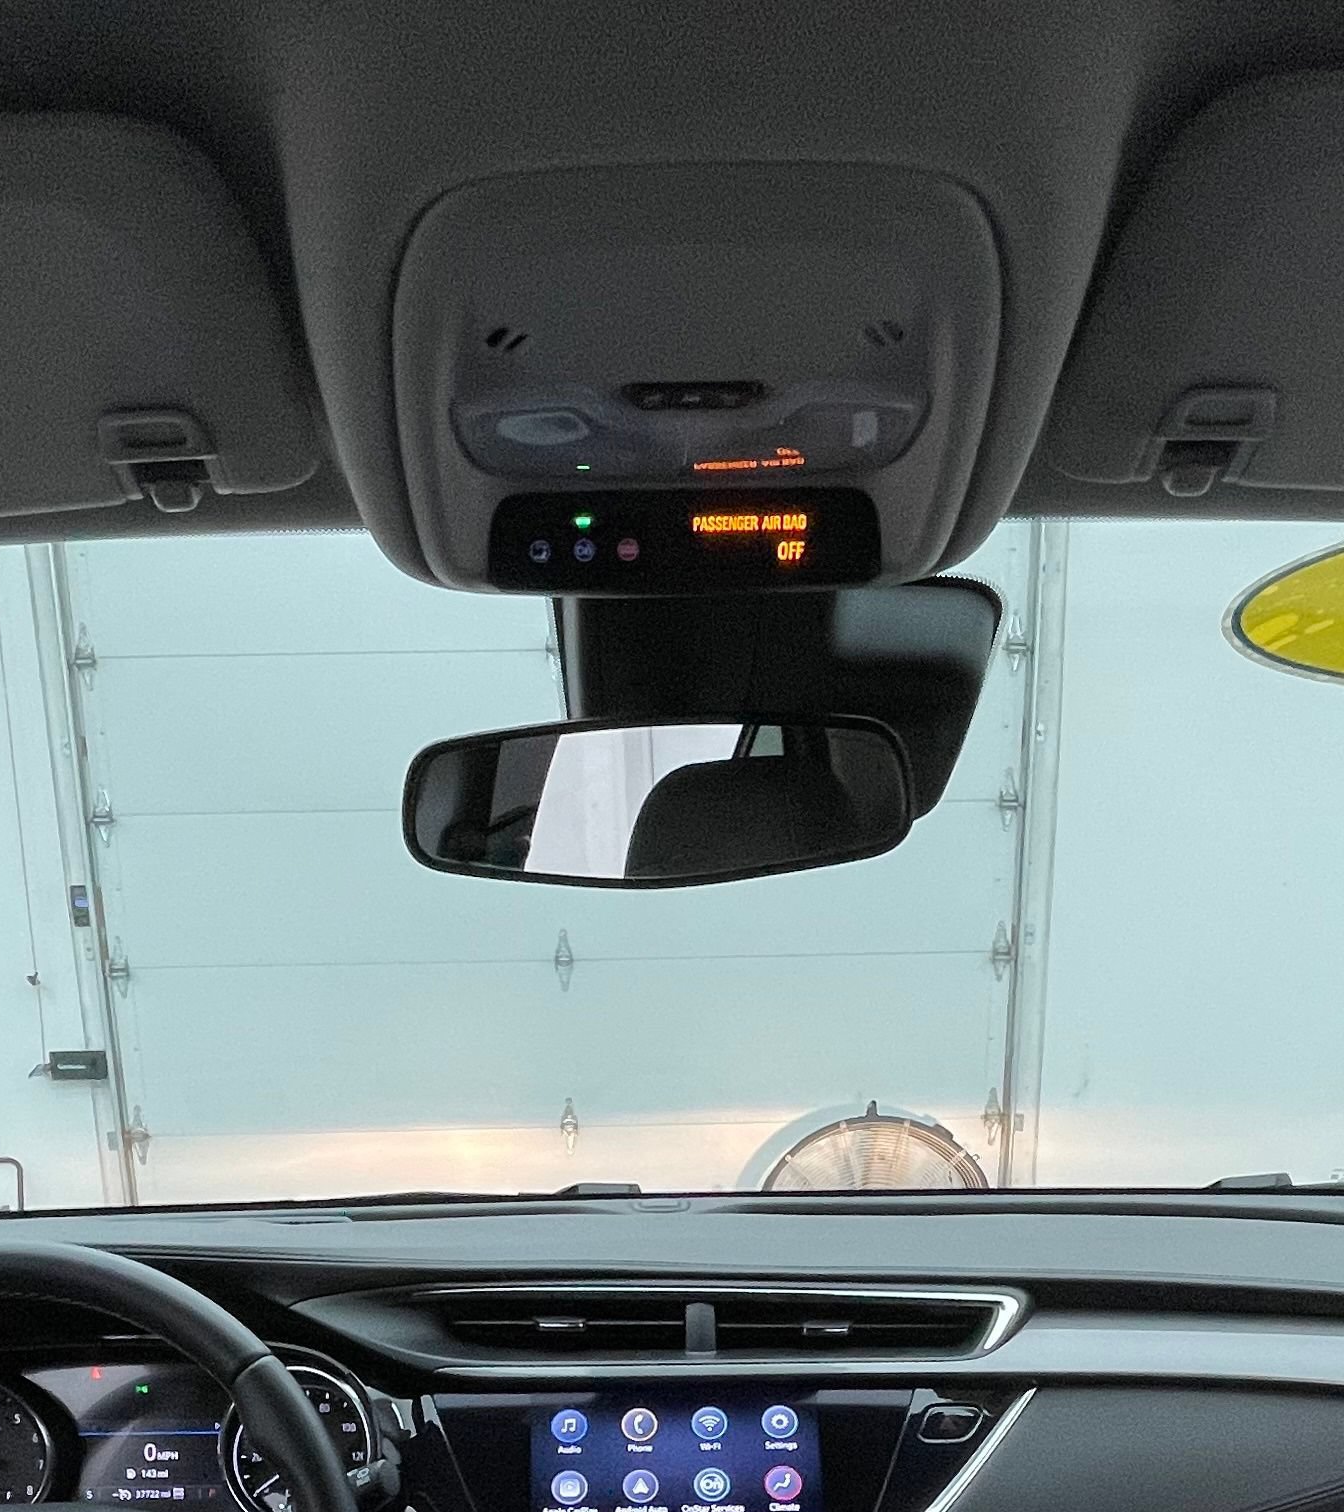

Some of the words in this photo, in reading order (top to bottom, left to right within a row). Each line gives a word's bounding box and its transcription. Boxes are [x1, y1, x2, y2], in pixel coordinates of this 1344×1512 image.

[692, 515, 759, 532] PASSENGER
[761, 515, 782, 531] AIR
[783, 513, 807, 531] BAG
[777, 541, 805, 560] OFF
[14, 1413, 21, 1425] 5
[32, 1433, 39, 1443] 6
[557, 1445, 582, 1454] Audio
[627, 1444, 654, 1453] Phone
[764, 1440, 799, 1452] Settings
[143, 1443, 156, 1462] 0
[157, 1451, 179, 1461] MPH
[141, 1469, 156, 1479] 143
[768, 1502, 801, 1512] Climate
